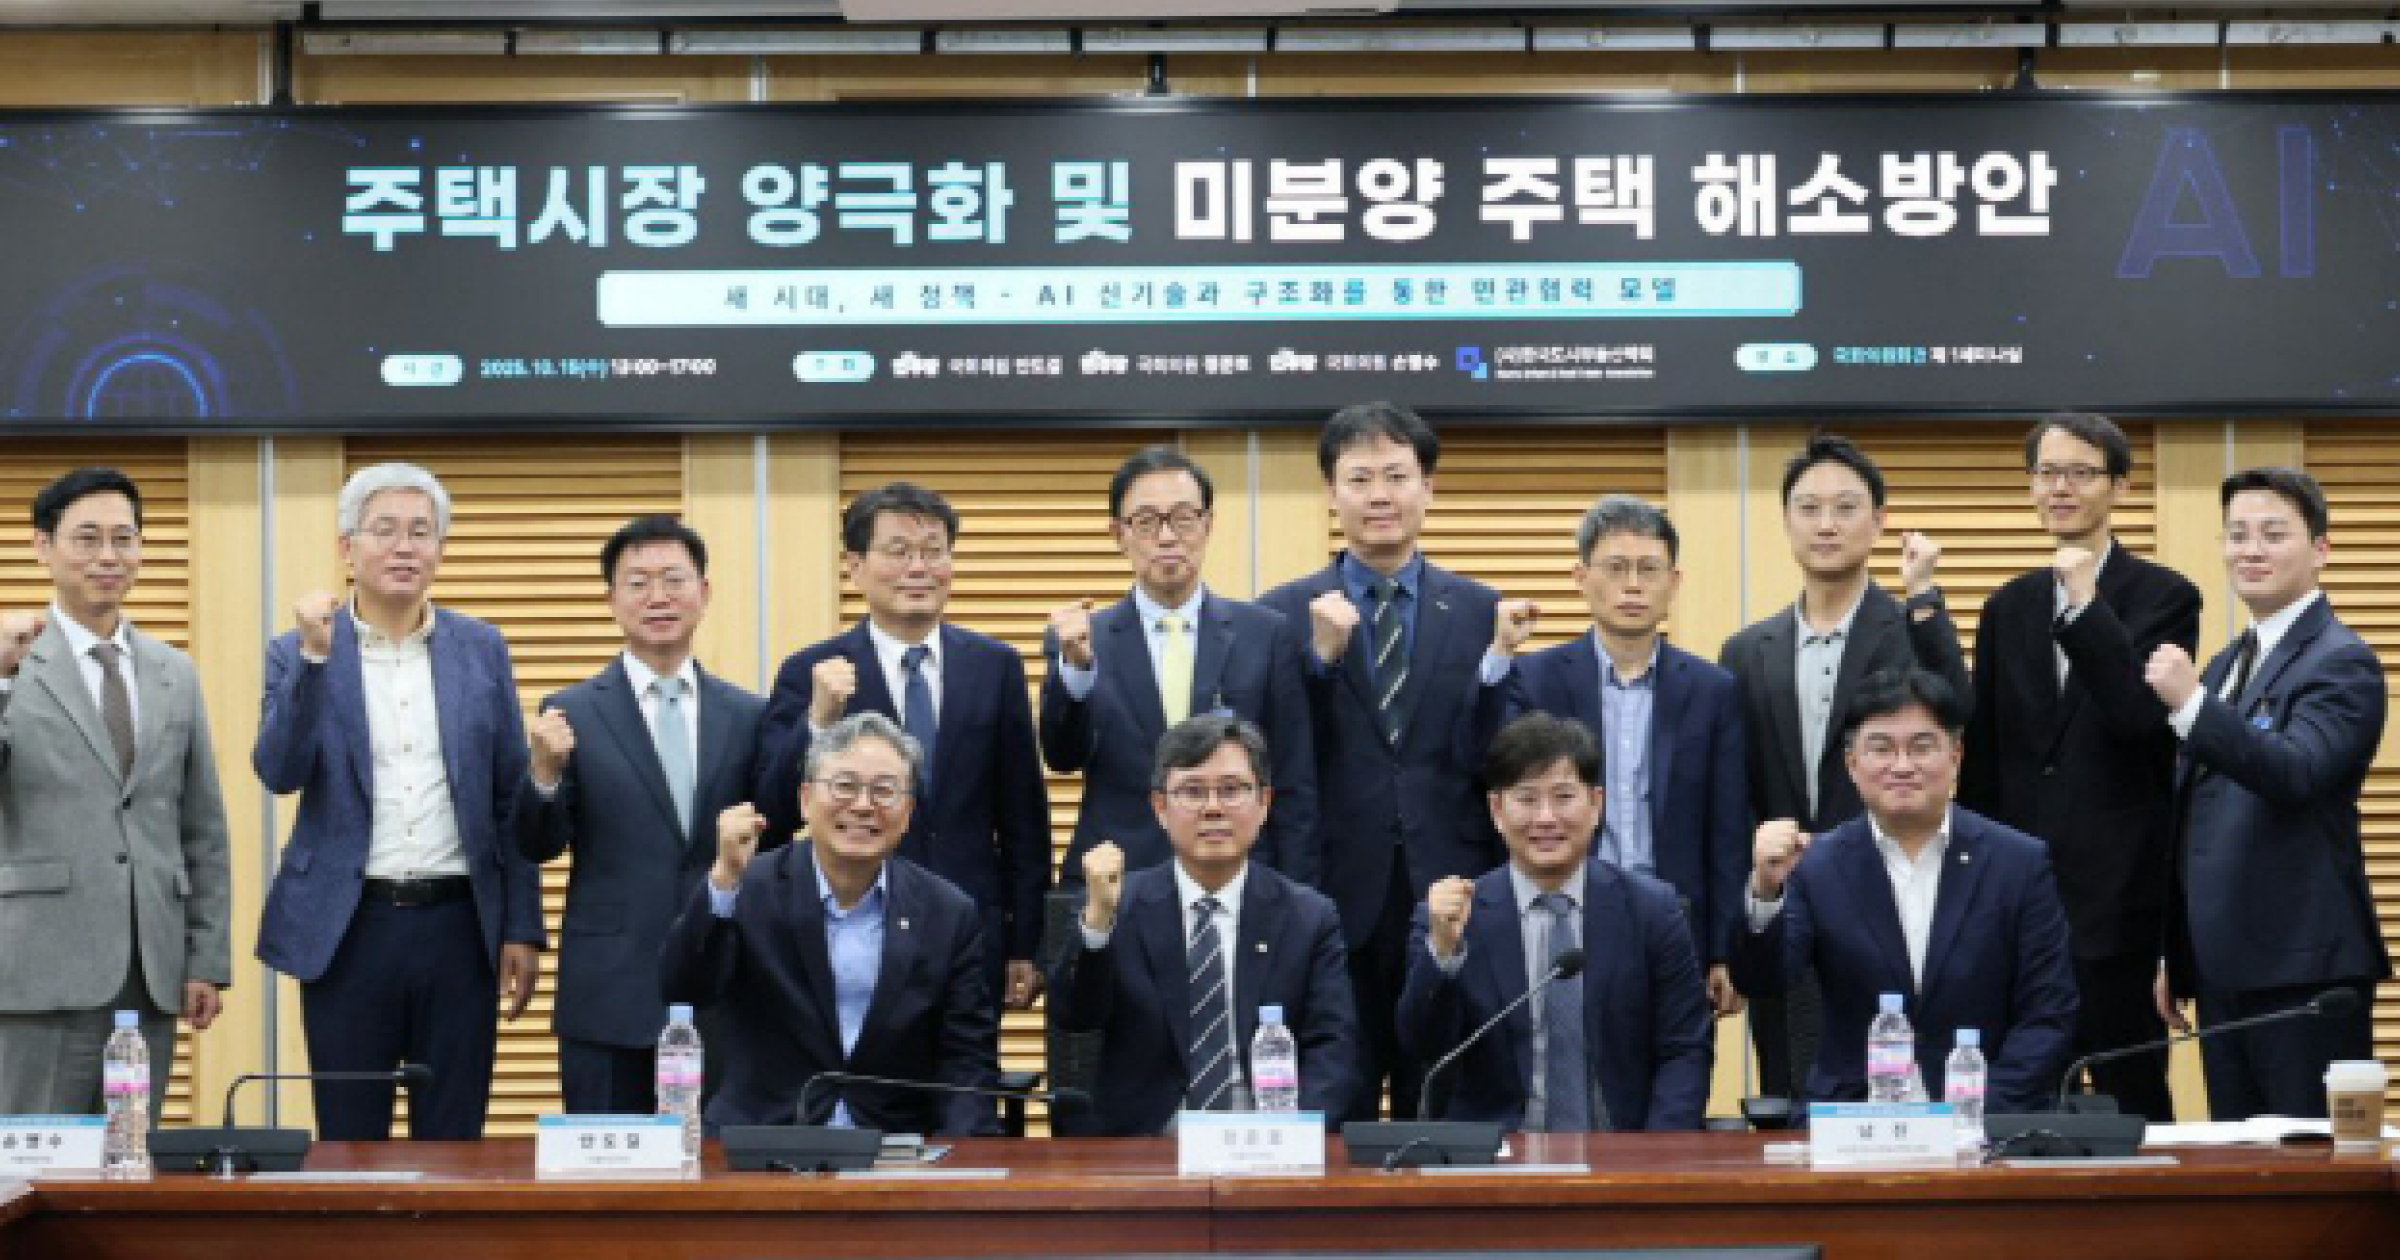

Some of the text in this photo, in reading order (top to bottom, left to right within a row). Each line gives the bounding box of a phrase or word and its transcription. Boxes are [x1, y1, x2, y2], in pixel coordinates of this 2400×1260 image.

[342, 150, 2059, 251] 주택시장 양극화 및 미분양 주택 해소방안
[2114, 126, 2315, 279] AI
[724, 285, 748, 309] 새
[773, 285, 845, 314] 시대,
[869, 285, 894, 309] 새
[919, 282, 976, 309] 정책
[1036, 284, 1074, 306] AI
[1099, 281, 1220, 308] 신기술과
[1244, 279, 1367, 306] 구조화를
[1390, 277, 1449, 305] 통한
[1620, 276, 1677, 303] 모델
